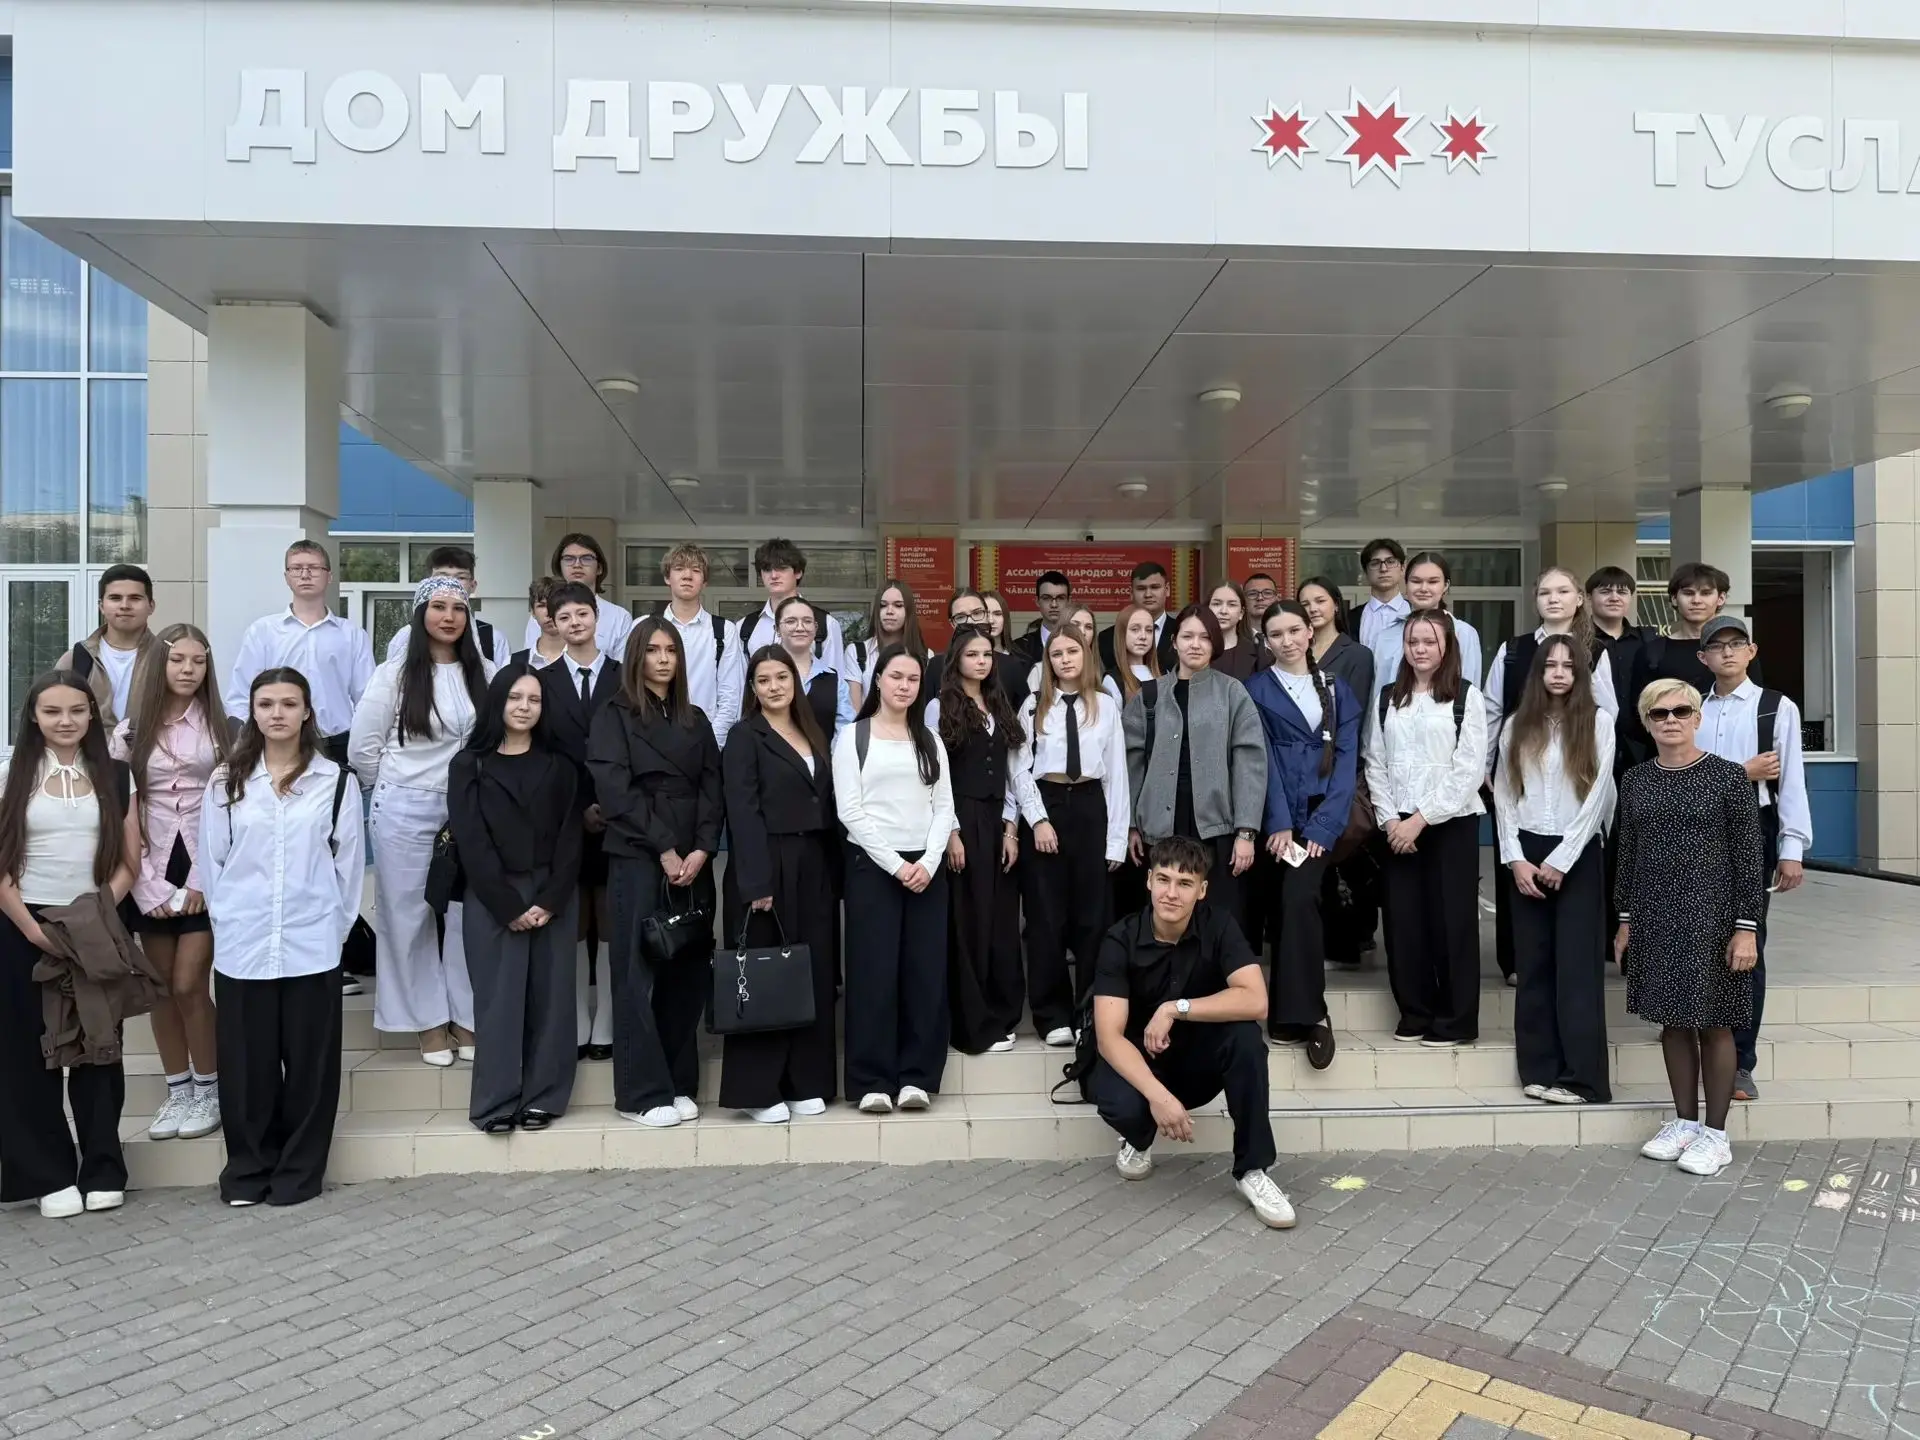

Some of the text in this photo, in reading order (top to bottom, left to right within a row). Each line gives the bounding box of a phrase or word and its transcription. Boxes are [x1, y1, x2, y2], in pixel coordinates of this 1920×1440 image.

[225, 68, 1088, 173] ДОМ ДРУЖБЫ
[1633, 111, 1920, 194] ТУСЛ
[1067, 569, 1114, 578] НАРОДОВ
